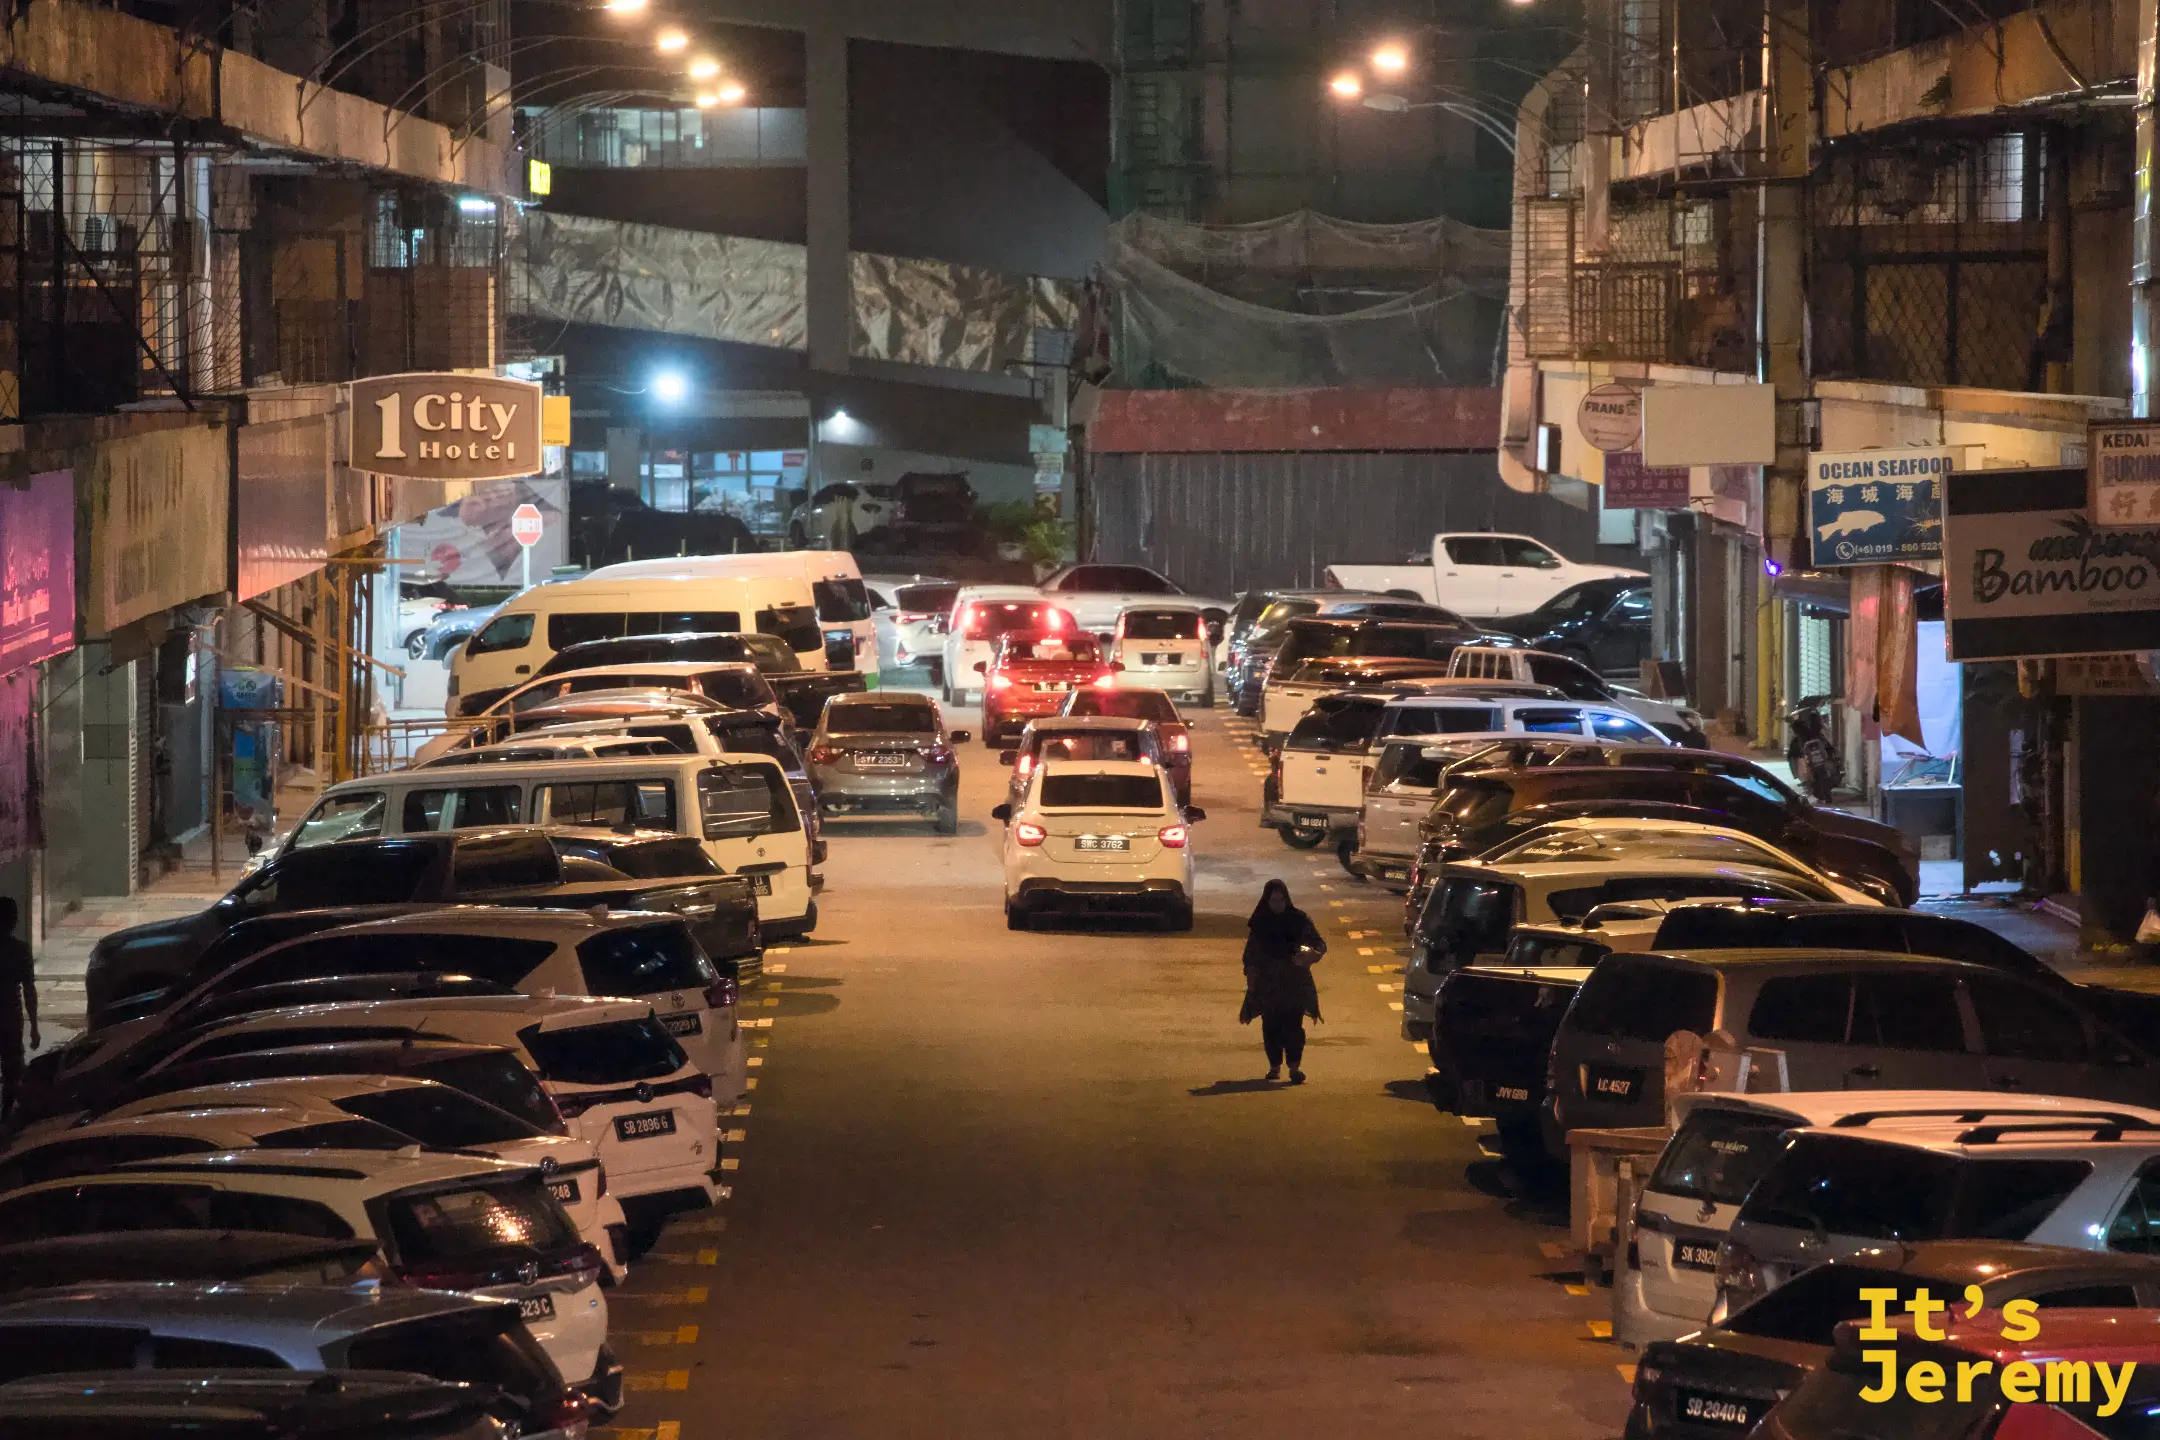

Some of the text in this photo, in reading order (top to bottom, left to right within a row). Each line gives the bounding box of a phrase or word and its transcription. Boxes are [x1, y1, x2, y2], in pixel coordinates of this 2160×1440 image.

[1585, 401, 1625, 415] FRANS
[375, 391, 518, 459] 1 City
[2102, 433, 2150, 449] KEDAI
[419, 441, 516, 460] Hotel
[1819, 456, 1954, 480] OCEAN SEAFOOD
[1875, 544, 1893, 554] 019
[1972, 548, 2149, 604] Bamboo
[1081, 840, 1124, 849] SWC 3762
[1609, 1079, 1632, 1095] 4527
[623, 1115, 669, 1135] SB 2896 G
[548, 1184, 571, 1200] 248
[541, 1297, 550, 1314] C
[1703, 1400, 1736, 1422] 2940
[1737, 1405, 1748, 1424] G
